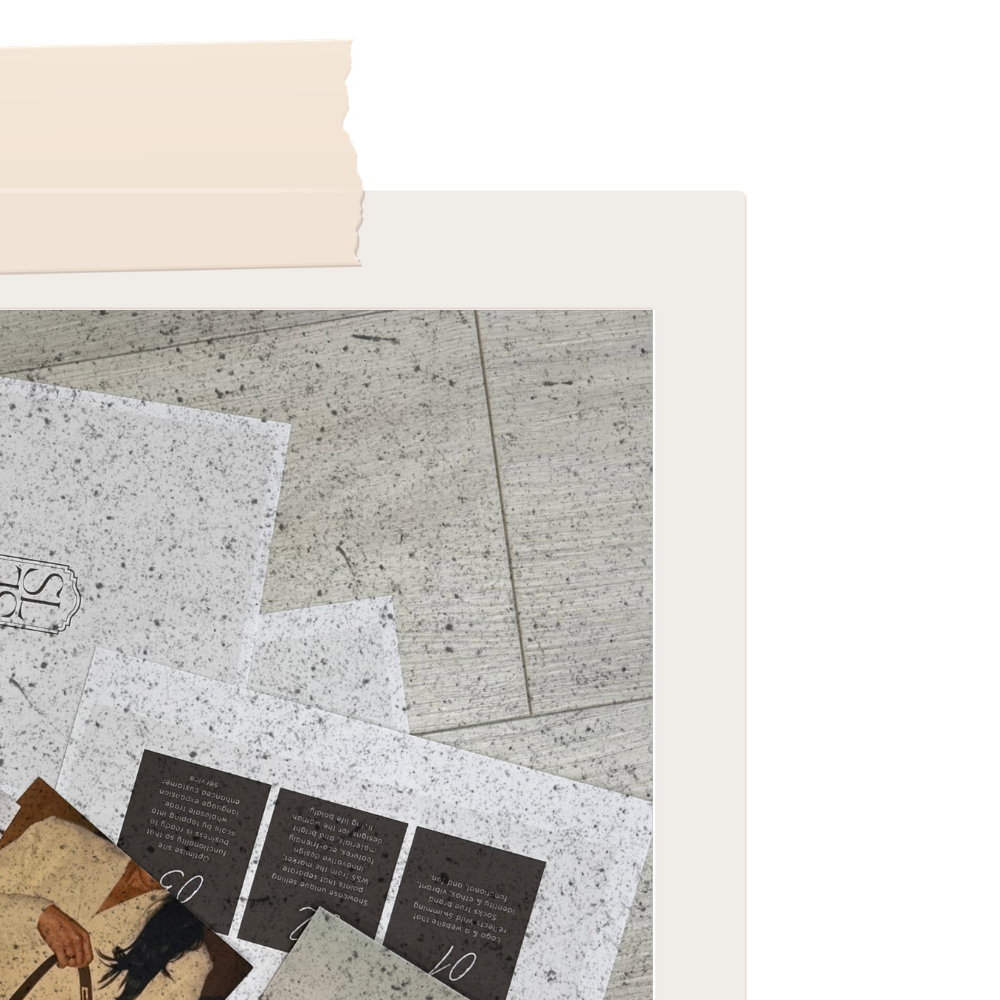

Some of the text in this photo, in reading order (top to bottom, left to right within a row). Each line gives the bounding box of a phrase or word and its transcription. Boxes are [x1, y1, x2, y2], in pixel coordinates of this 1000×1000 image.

[189, 775, 218, 788] service
[161, 779, 241, 805] enhanced customer
[188, 807, 228, 823] wholesale
[201, 800, 239, 817] language
[168, 811, 200, 827] tapping
[201, 821, 212, 831] by
[336, 816, 349, 826] life
[149, 818, 230, 846] business is ready to
[214, 825, 236, 837] scale
[292, 814, 383, 845] designs for the woman
[292, 825, 317, 838] bright
[318, 832, 335, 842] and
[146, 828, 227, 857] functionality so that
[288, 833, 338, 853] eco-friendly
[157, 842, 210, 863] Optimise site
[293, 847, 364, 872] innovative design
[315, 864, 328, 873] the
[330, 868, 349, 880] from
[282, 865, 364, 893] points that separate
[351, 874, 369, 885] WSS
[446, 879, 463, 889] and
[271, 872, 369, 907] Showcase unique selling
[428, 896, 498, 921] Socks true brand
[476, 898, 483, 906] &
[484, 900, 515, 915] identity
[412, 913, 430, 923] that
[413, 901, 507, 934] reflects Wild Swimming
[431, 918, 462, 932] website
[472, 930, 479, 938] &
[480, 932, 501, 944] Logo
[428, 945, 477, 981] 01
